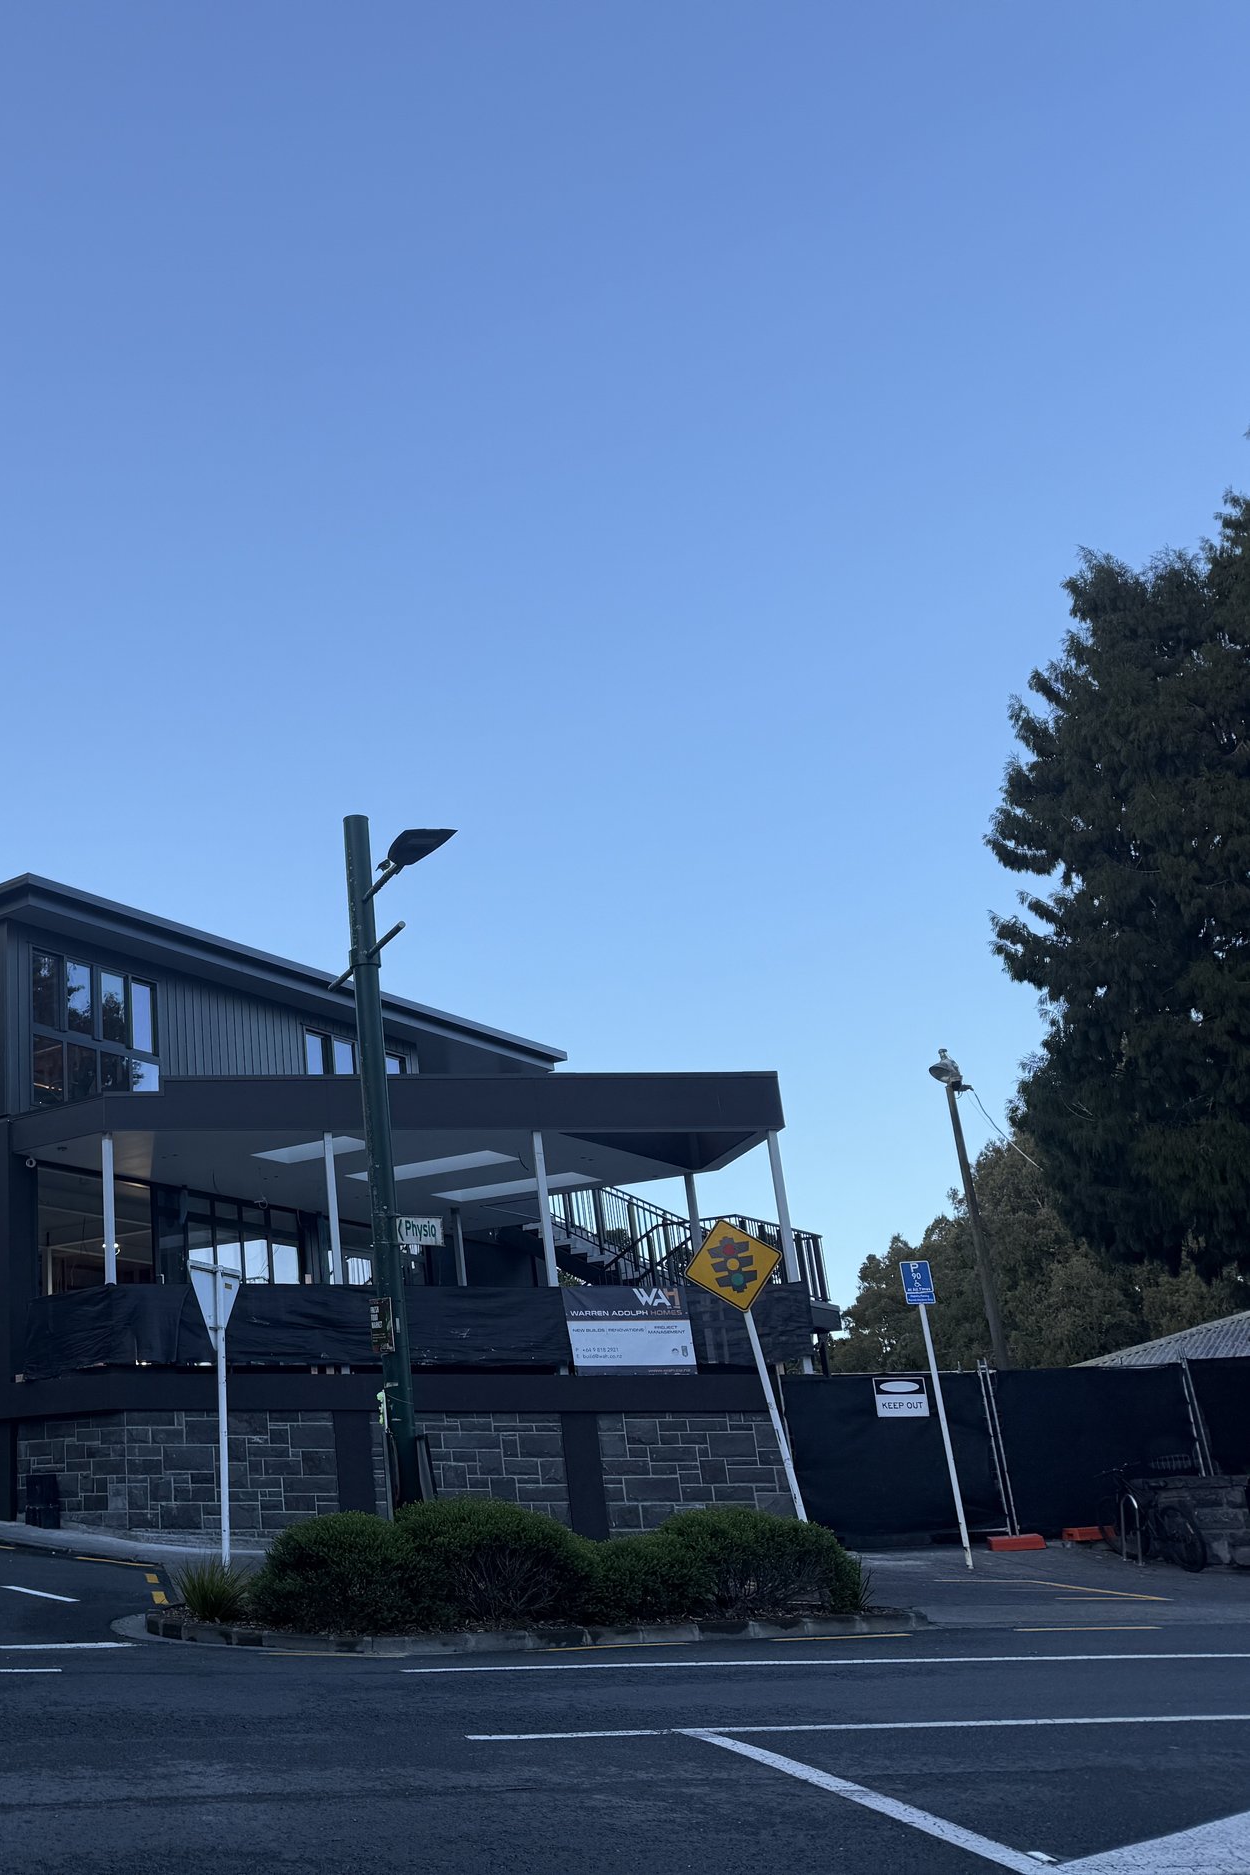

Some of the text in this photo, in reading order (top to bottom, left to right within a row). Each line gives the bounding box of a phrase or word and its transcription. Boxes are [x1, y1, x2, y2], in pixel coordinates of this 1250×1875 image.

[405, 1220, 436, 1241] Physio
[910, 1263, 919, 1272] P
[632, 1288, 680, 1306] WAH
[907, 1401, 923, 1409] OUT
